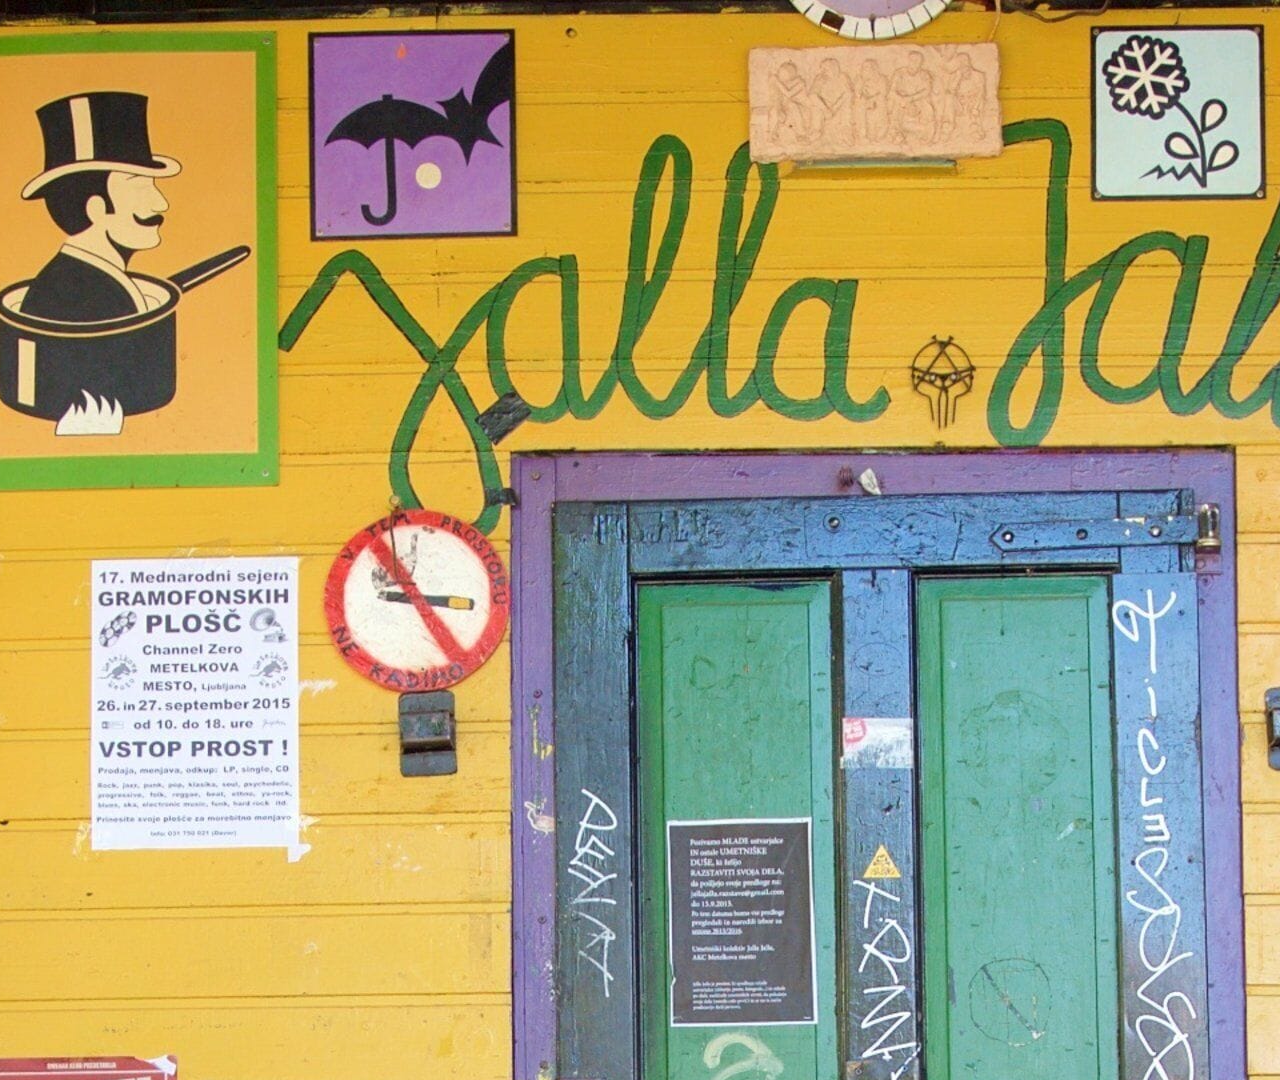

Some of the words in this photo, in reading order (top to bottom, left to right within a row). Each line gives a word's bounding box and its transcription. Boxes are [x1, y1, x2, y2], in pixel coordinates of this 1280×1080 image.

[99, 572, 124, 584] 17.
[131, 571, 231, 583] Mednarodni
[237, 570, 288, 582] sejem
[98, 589, 289, 608] GRAMOFONSKIH
[146, 609, 242, 633] PLOŠČ
[143, 644, 203, 655] Channel
[208, 644, 242, 655] Zero
[150, 663, 239, 673] METELKOVA
[143, 681, 197, 692] MESTO,
[201, 682, 246, 692] Ljubljana
[97, 700, 120, 712] 26.
[123, 702, 135, 711] in
[139, 700, 161, 711] 27.
[166, 699, 249, 713] september
[253, 698, 290, 709] 2015
[134, 720, 151, 730] od
[157, 719, 177, 729] 10.
[182, 719, 199, 729] do
[205, 719, 225, 729] 18.
[231, 720, 253, 729] ure
[99, 741, 181, 758] VSTOP
[191, 740, 273, 757] PROST
[282, 740, 288, 756] !
[98, 767, 136, 776] Prodaja,
[140, 767, 183, 775] menjava,
[186, 766, 217, 774] odkup:
[223, 766, 238, 774] LP,
[720, 847, 767, 856] UMETNIŠKE
[690, 858, 714, 866] DUŠE,
[690, 869, 735, 877] RAZSTAVITI
